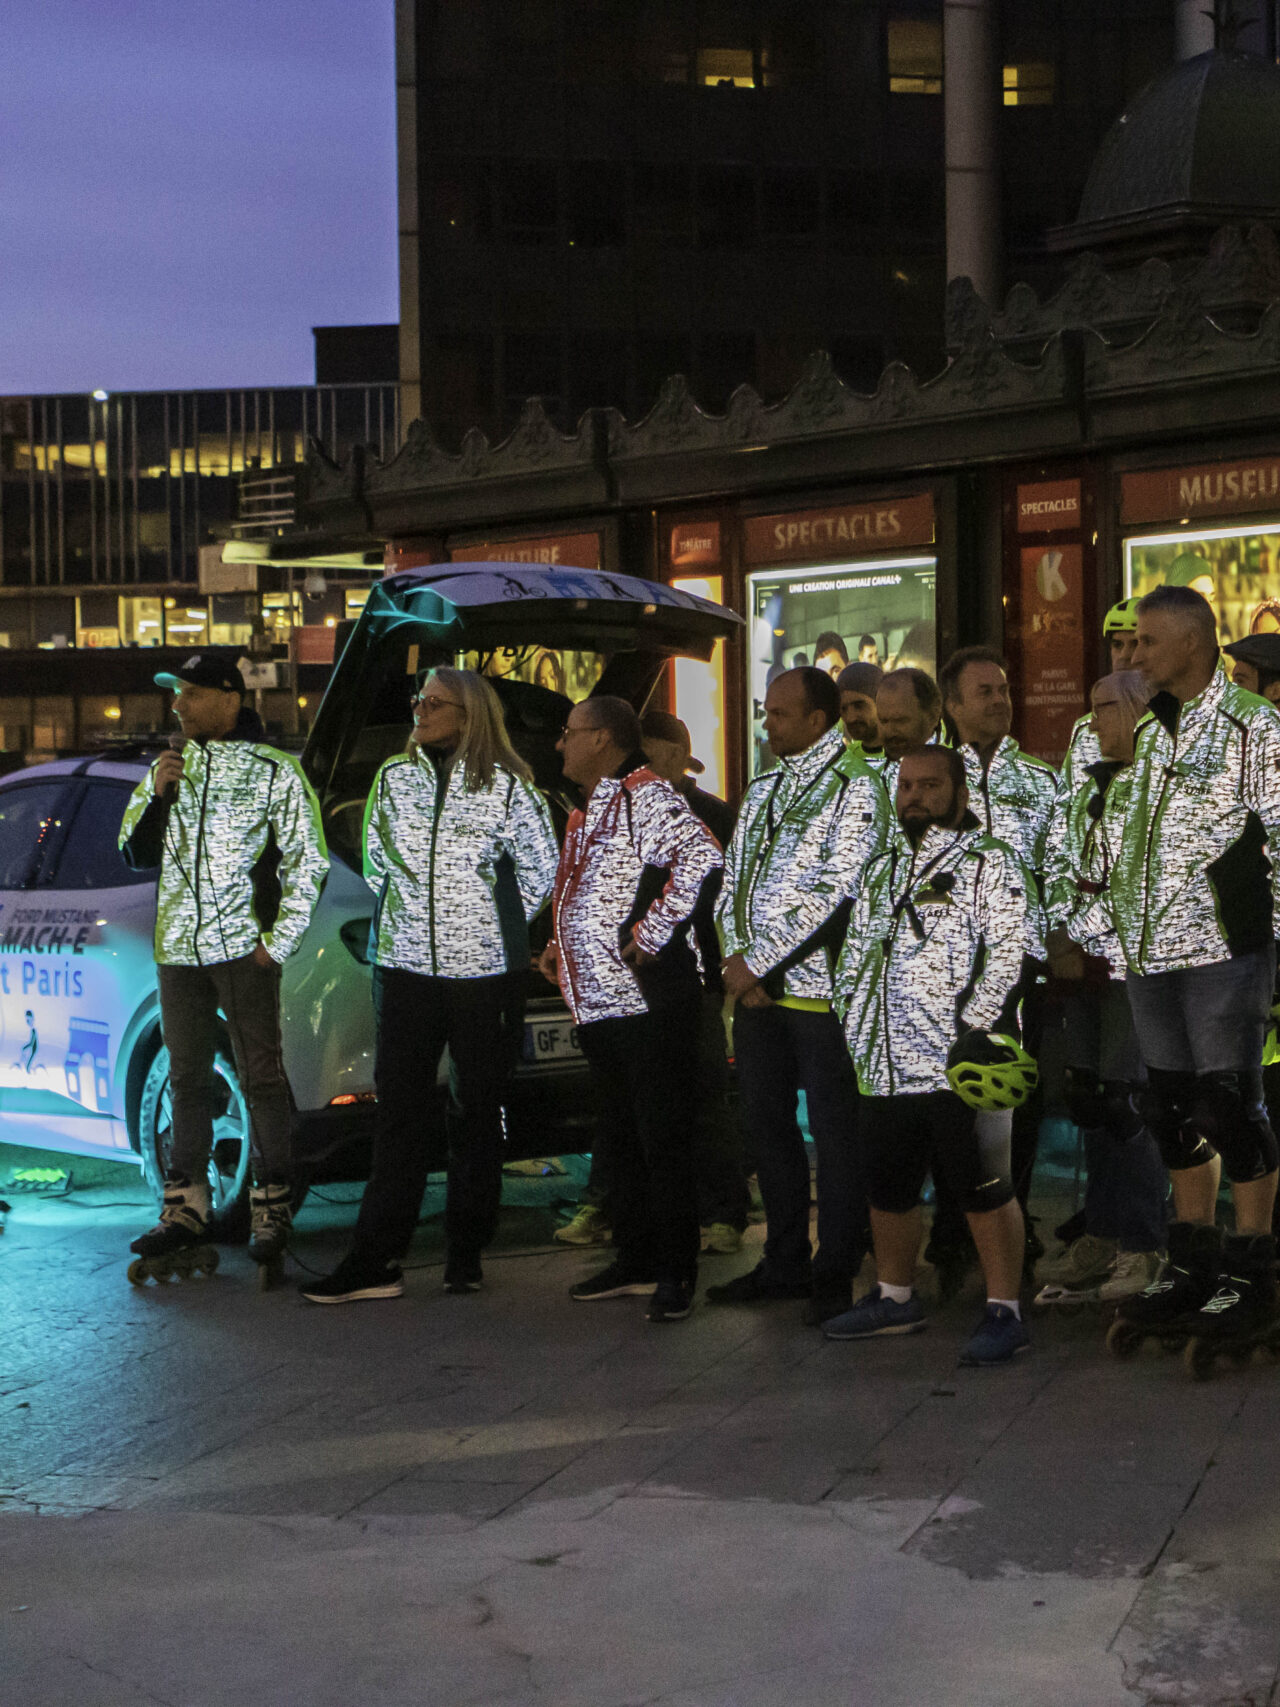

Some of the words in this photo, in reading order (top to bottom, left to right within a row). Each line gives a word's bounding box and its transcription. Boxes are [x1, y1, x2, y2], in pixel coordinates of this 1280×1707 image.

[1021, 498, 1078, 516] SPECTACLES
[774, 509, 900, 551] SPECTACLES
[788, 583, 803, 594] UNE
[0, 926, 90, 955] MACH-E
[23, 961, 83, 997] Paris
